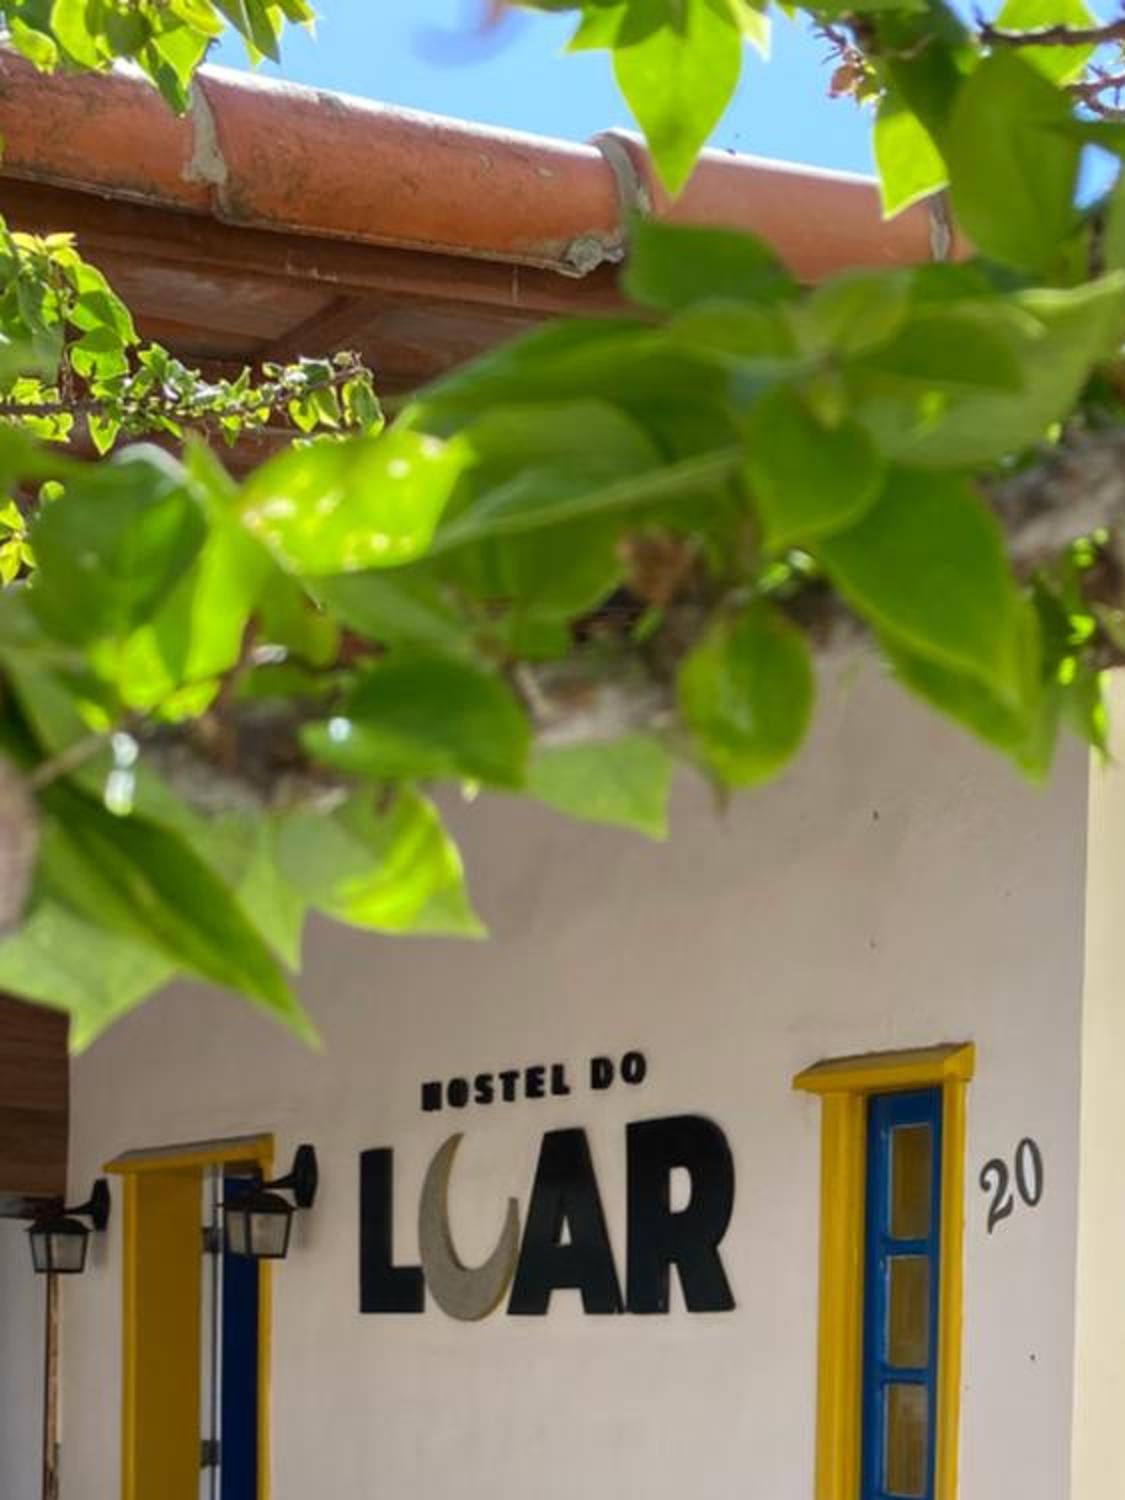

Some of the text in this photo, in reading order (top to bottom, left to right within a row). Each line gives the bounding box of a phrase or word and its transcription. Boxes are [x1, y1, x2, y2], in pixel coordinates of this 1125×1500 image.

[420, 1050, 647, 1113] HOSTEL DO
[359, 1114, 736, 1322] LUAR
[979, 1136, 1044, 1234] 20
